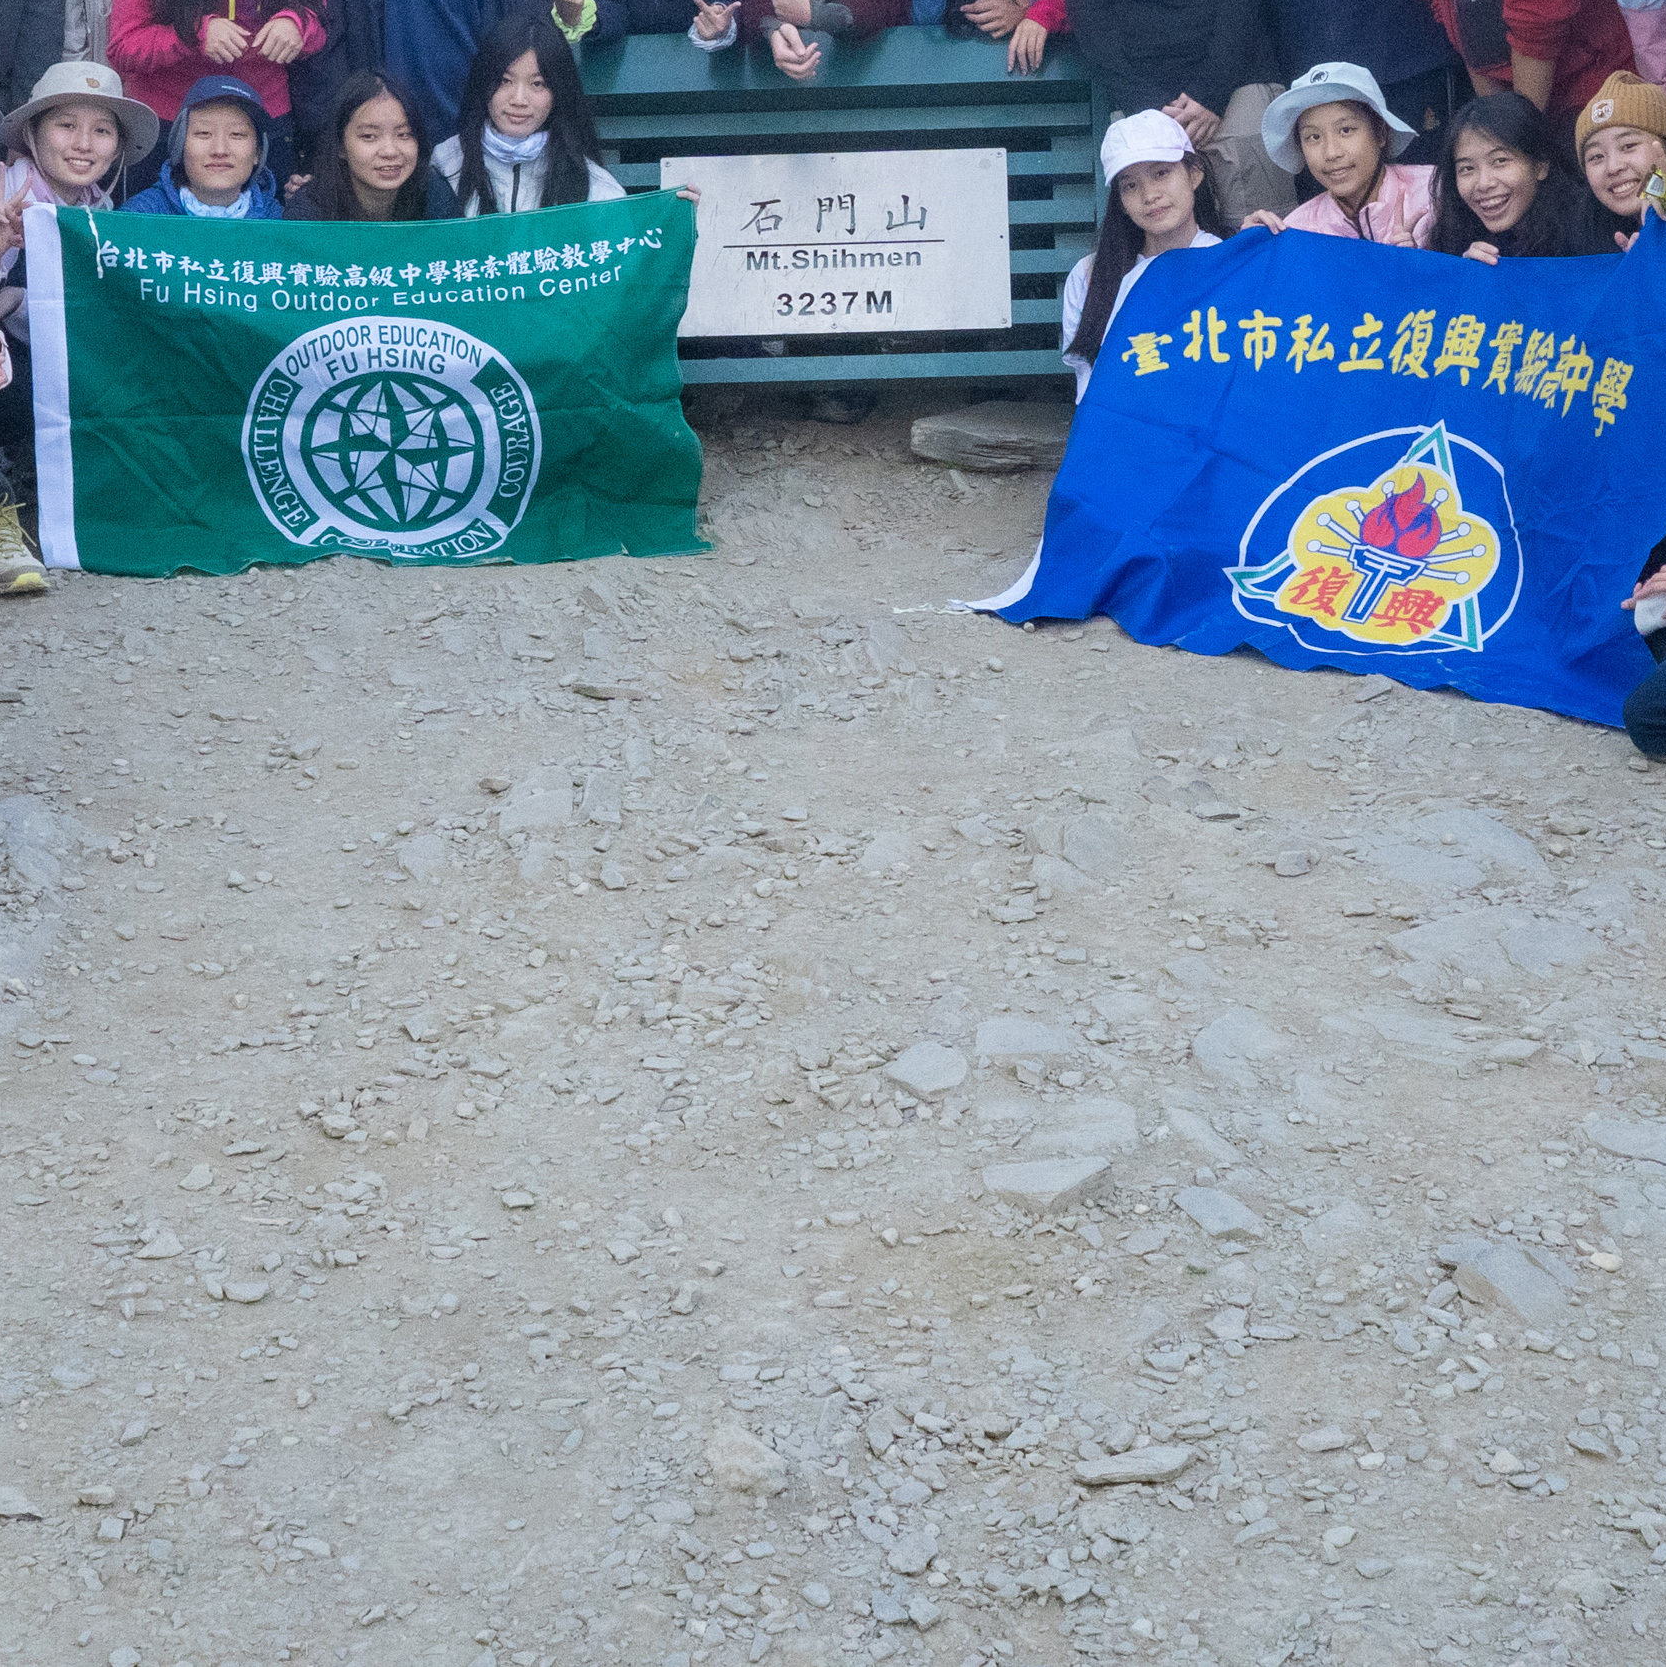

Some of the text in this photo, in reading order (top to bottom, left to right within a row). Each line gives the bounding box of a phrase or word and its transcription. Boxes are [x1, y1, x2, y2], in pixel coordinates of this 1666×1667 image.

[740, 193, 927, 235] 石門山
[140, 265, 622, 312] Fu Hsing Outdoor Education Center
[286, 325, 482, 377] OUTDOOR EDUCATION
[325, 347, 446, 381] FU HSING
[254, 378, 310, 528] CHALLENGE
[489, 381, 530, 498] COURAGE
